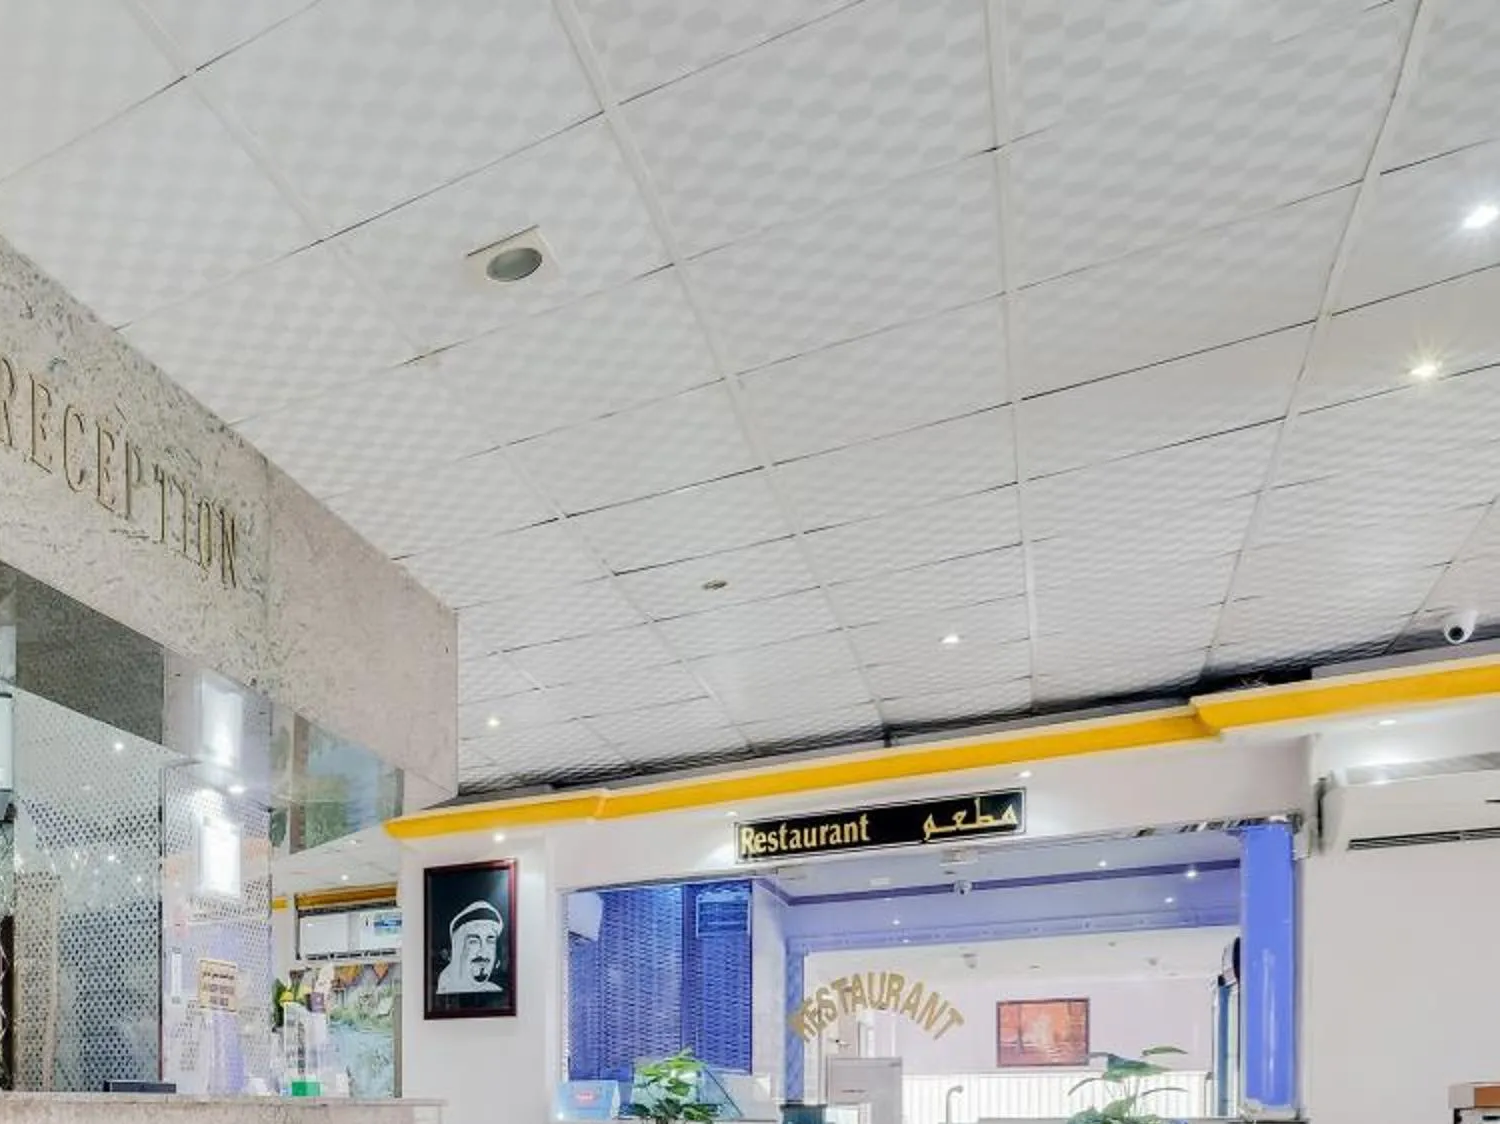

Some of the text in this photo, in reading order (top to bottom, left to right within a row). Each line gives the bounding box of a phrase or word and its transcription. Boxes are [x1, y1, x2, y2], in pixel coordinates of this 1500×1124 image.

[740, 813, 870, 856] Restaurant
[922, 798, 1018, 842] مطعم
[789, 970, 966, 1043] RESTAURANT
